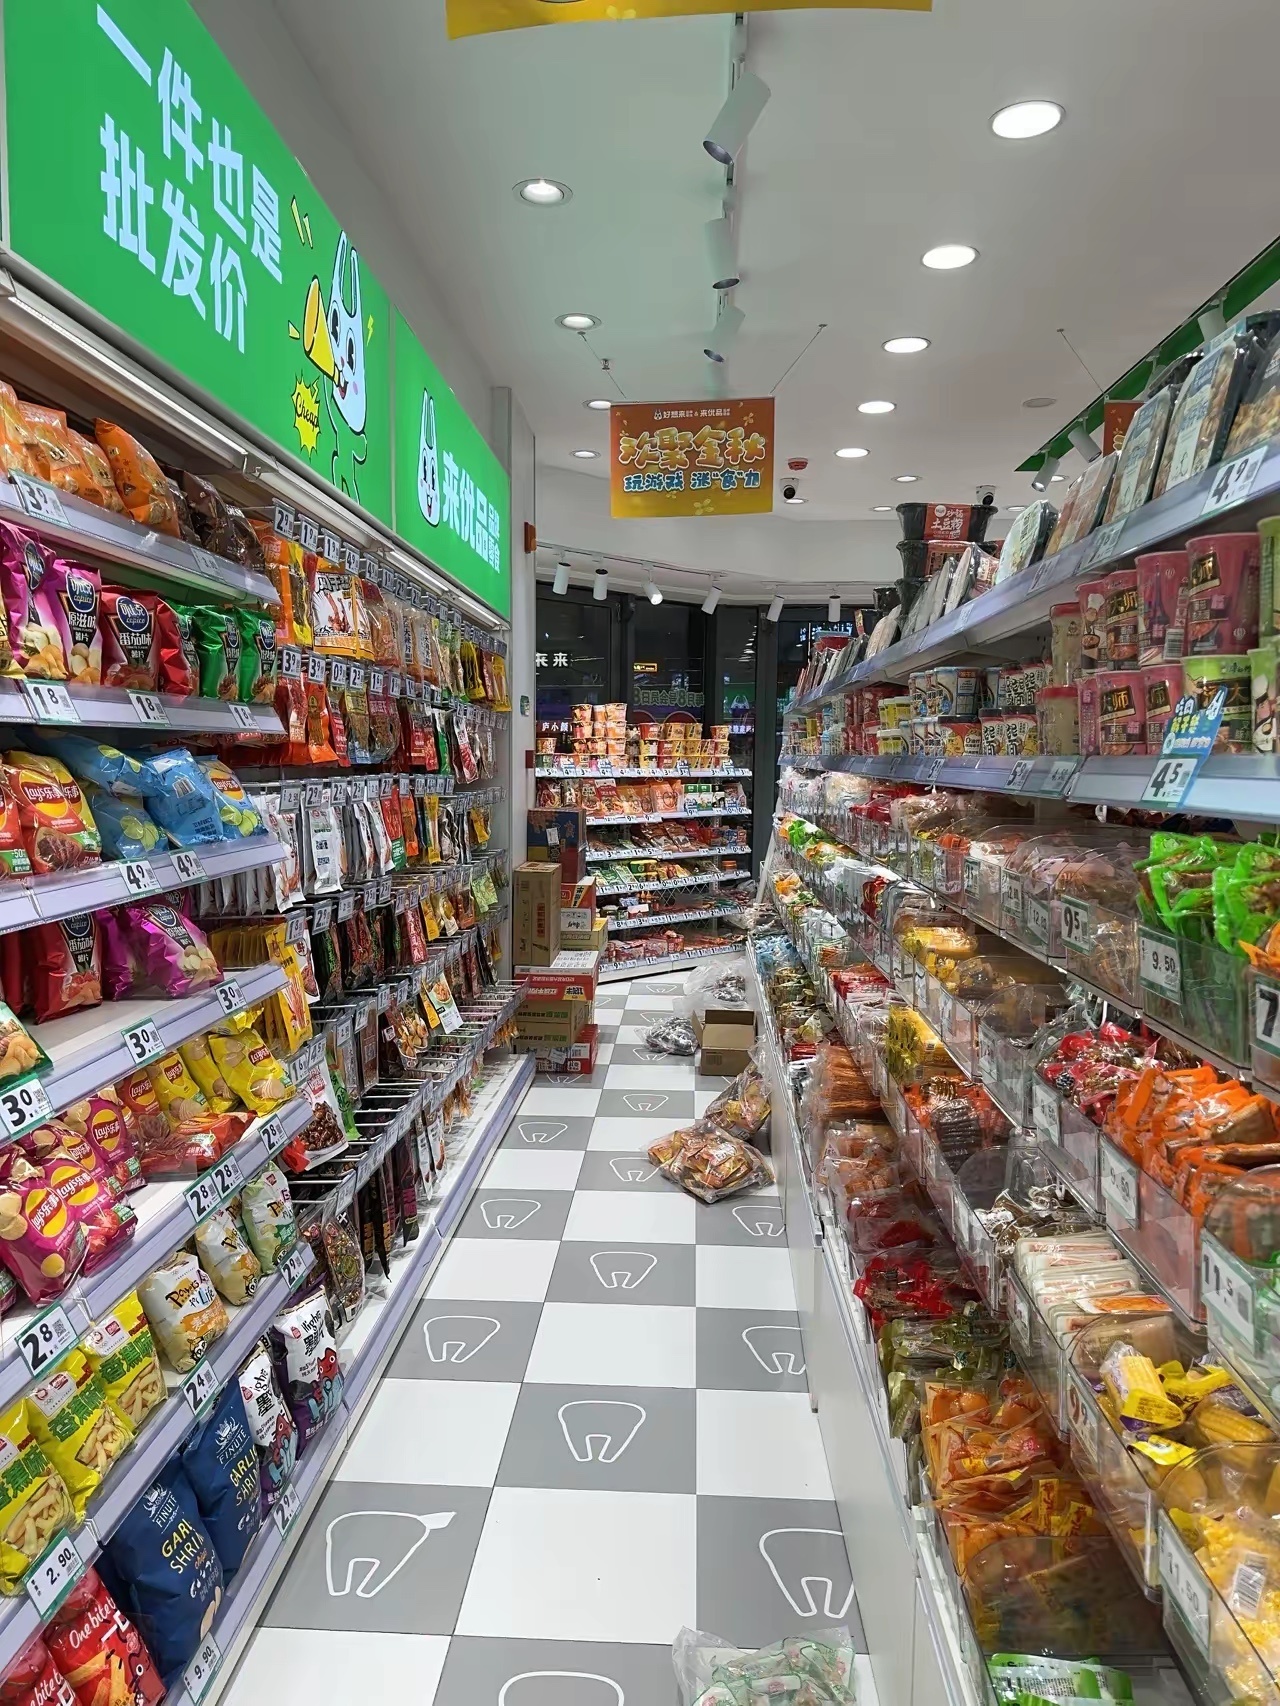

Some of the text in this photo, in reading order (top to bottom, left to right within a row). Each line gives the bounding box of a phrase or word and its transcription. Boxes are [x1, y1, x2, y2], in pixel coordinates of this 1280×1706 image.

[97, 4, 283, 284] 一件也是
[100, 113, 248, 354] 批发价
[295, 391, 319, 432] Cheap
[618, 424, 766, 471] 欢聚金秋
[623, 470, 685, 492] 玩游戏
[442, 450, 489, 563] 来优品
[69, 611, 97, 630] 原滋味
[119, 631, 152, 647] 番茄味
[21, 1322, 54, 1371] 2.8
[69, 1623, 92, 1650] One
